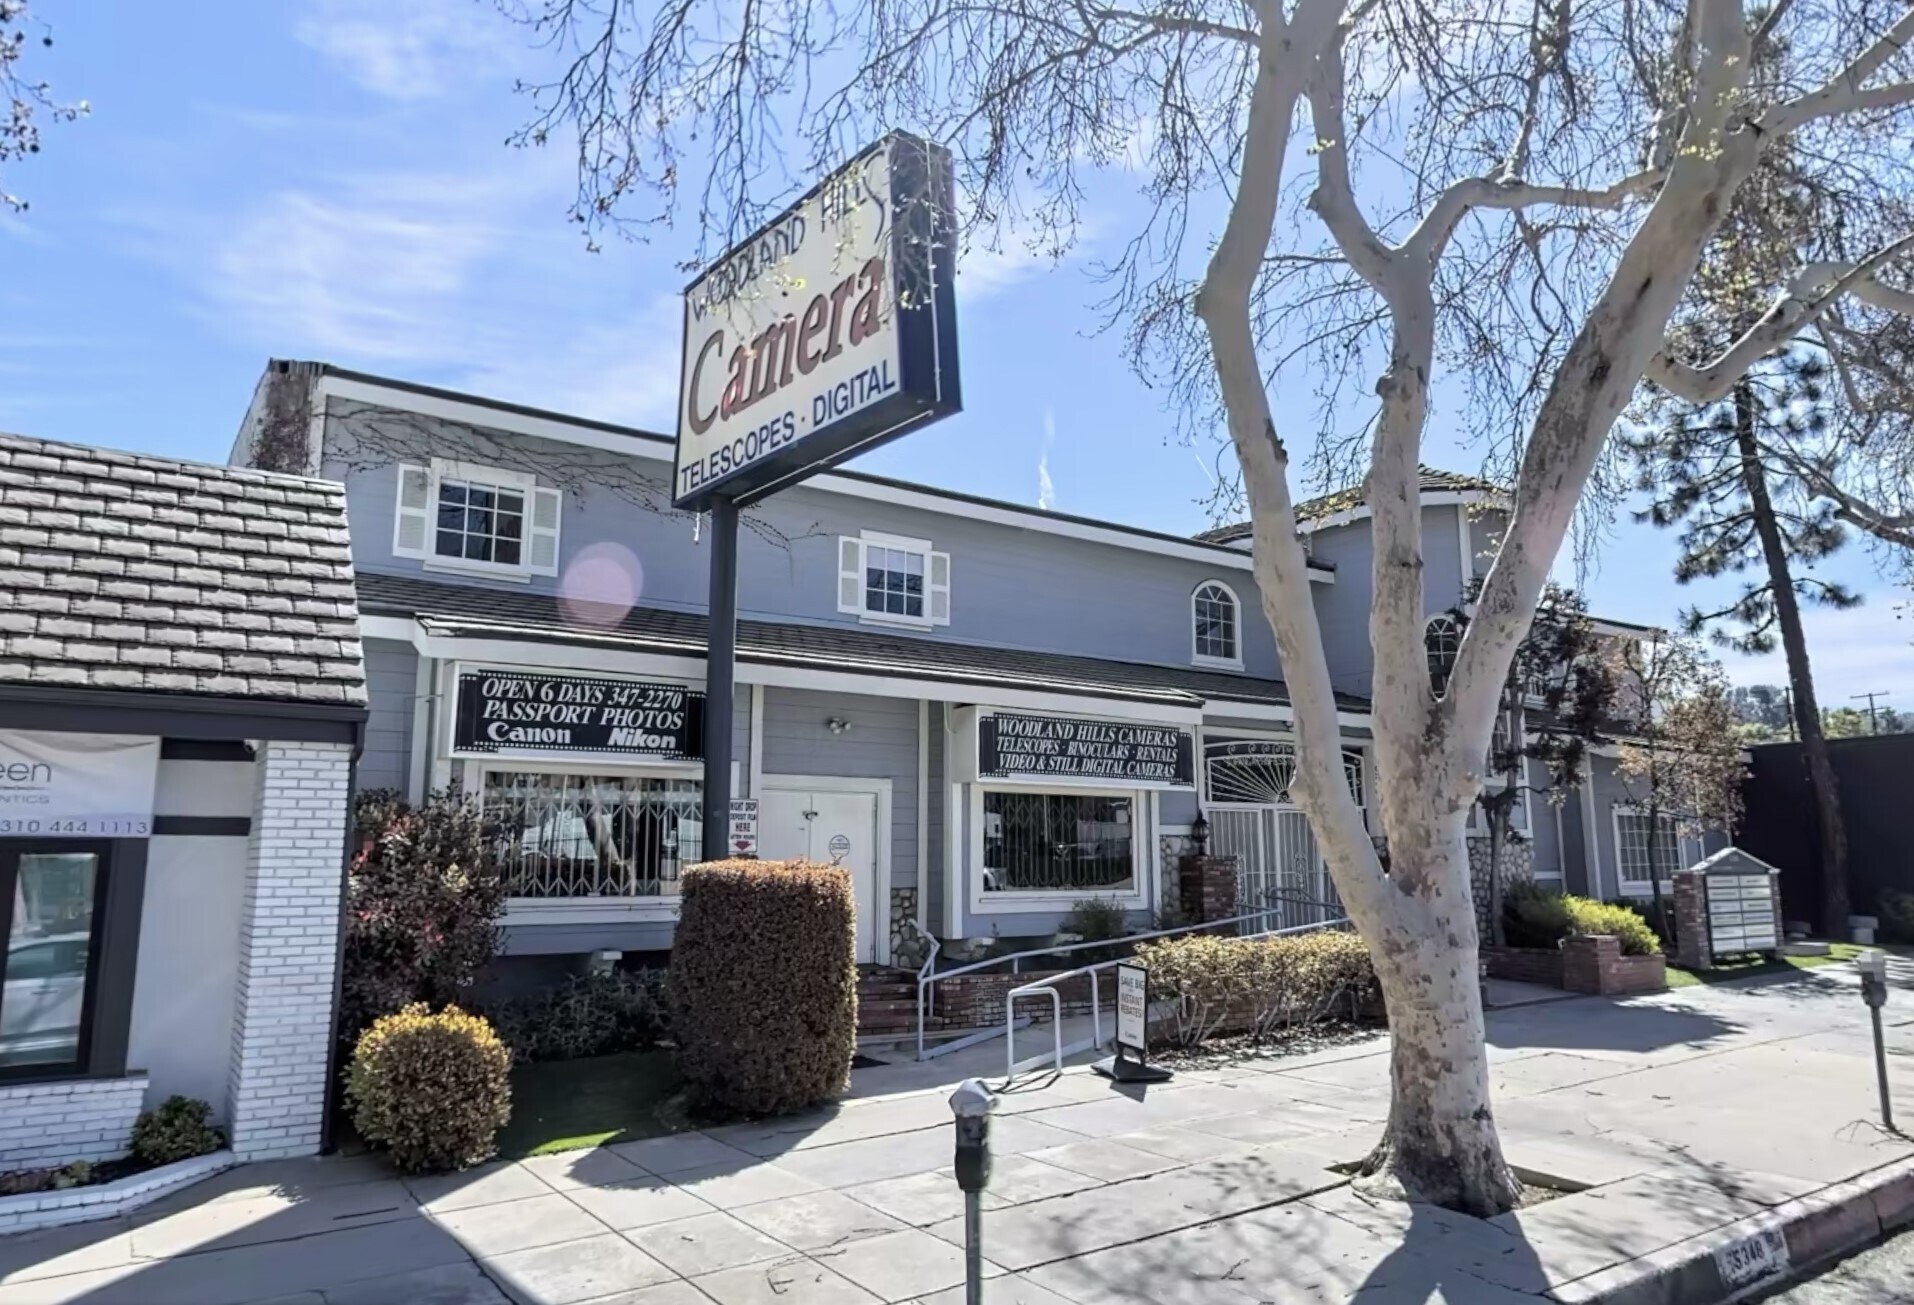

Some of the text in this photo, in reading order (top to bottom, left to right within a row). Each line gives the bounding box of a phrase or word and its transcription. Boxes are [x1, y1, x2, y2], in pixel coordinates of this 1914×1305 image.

[821, 150, 886, 245] HILLS
[688, 257, 885, 436] Camera
[680, 359, 896, 493] TELESCOPES DIGITAL
[481, 678, 683, 710] OPEN 6 DAYS 347-2270
[483, 700, 685, 730] PASSPORT PHOTOS
[486, 721, 677, 749] Canon Nikon
[997, 718, 1179, 747] WOODLAND HILLS CAMERAS
[997, 736, 1178, 762] TELESCOPES BINOCULARS RENTALS
[0, 762, 51, 782] en
[999, 752, 1176, 778] VIDEO & STILL DIGITAL CAMERAS
[49, 820, 88, 833] 444
[100, 820, 149, 834] 1113
[735, 822, 750, 832] HERE
